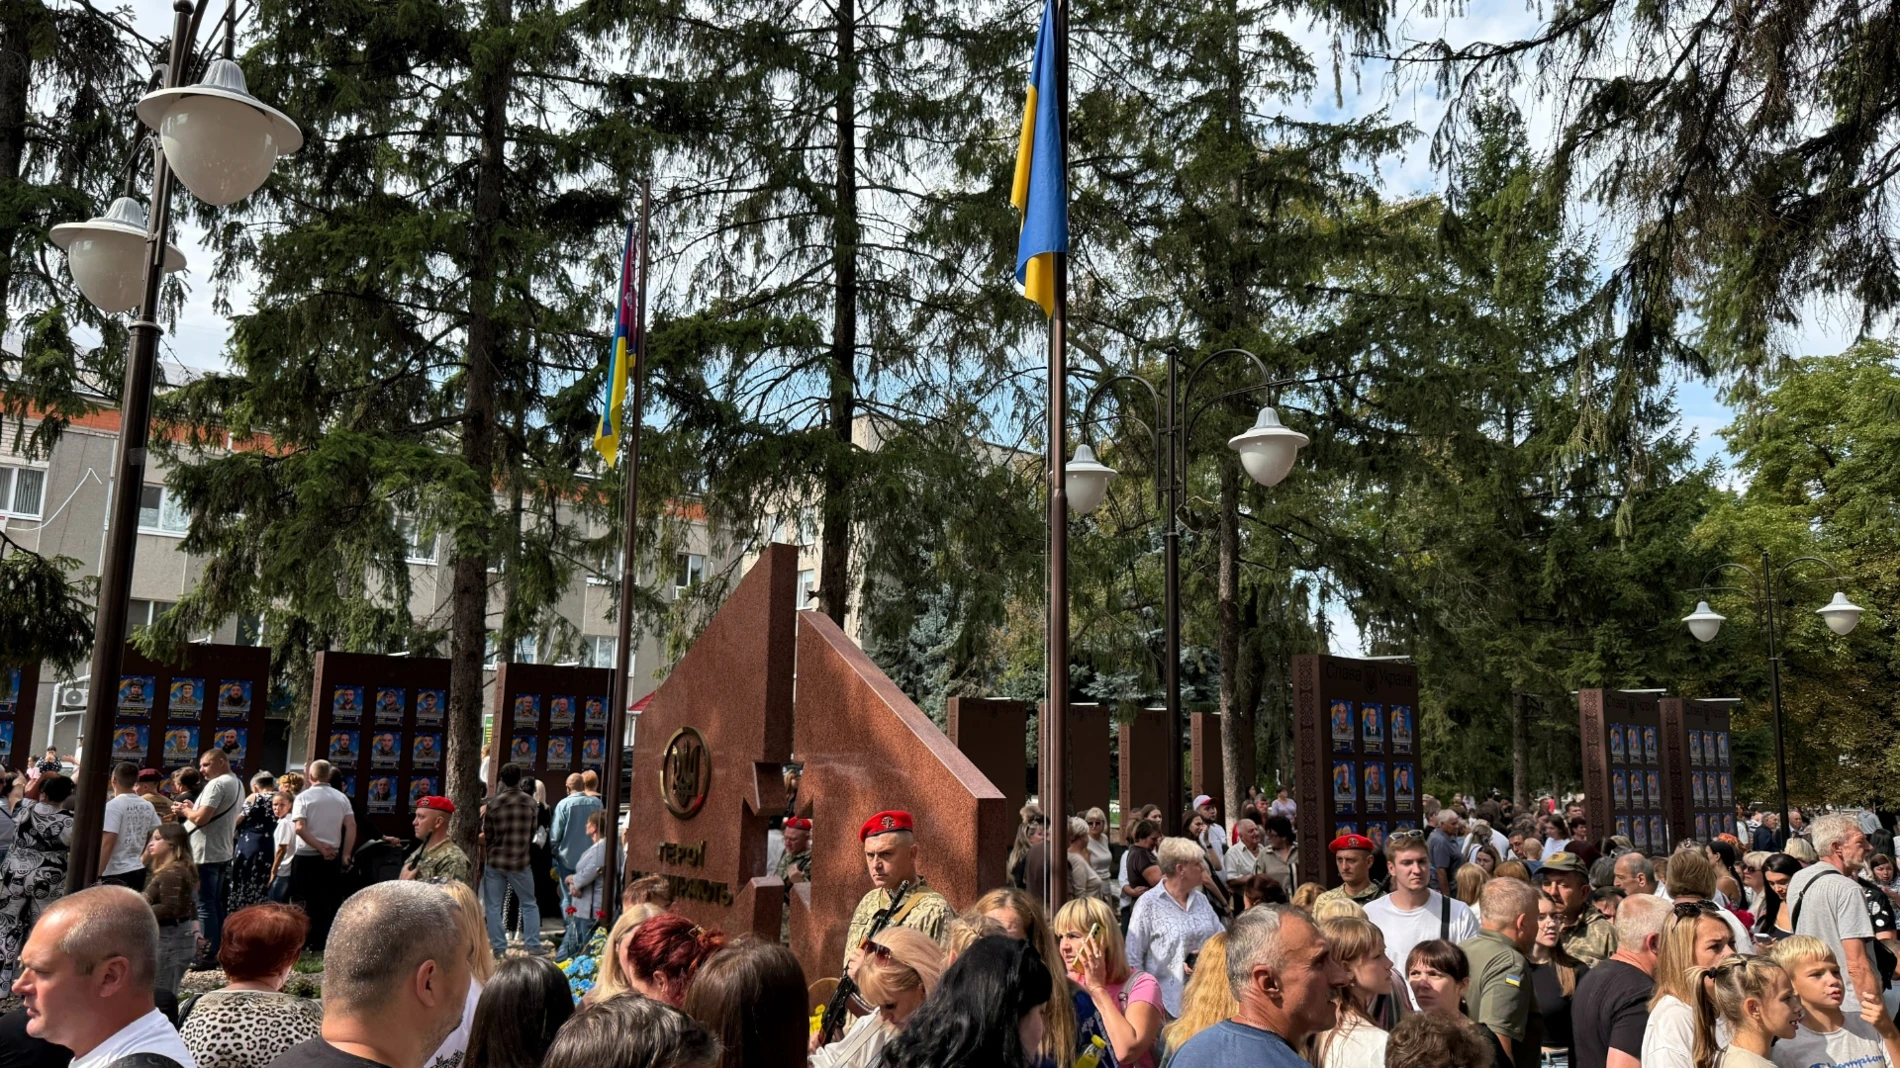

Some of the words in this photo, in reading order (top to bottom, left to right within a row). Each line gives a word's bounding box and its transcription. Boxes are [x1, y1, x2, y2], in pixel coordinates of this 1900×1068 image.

[1326, 661, 1362, 682] Слава
[1379, 668, 1413, 688] Україні
[658, 840, 707, 868] ГЕРОЇ
[660, 874, 734, 907] ИРАЮТЬ
